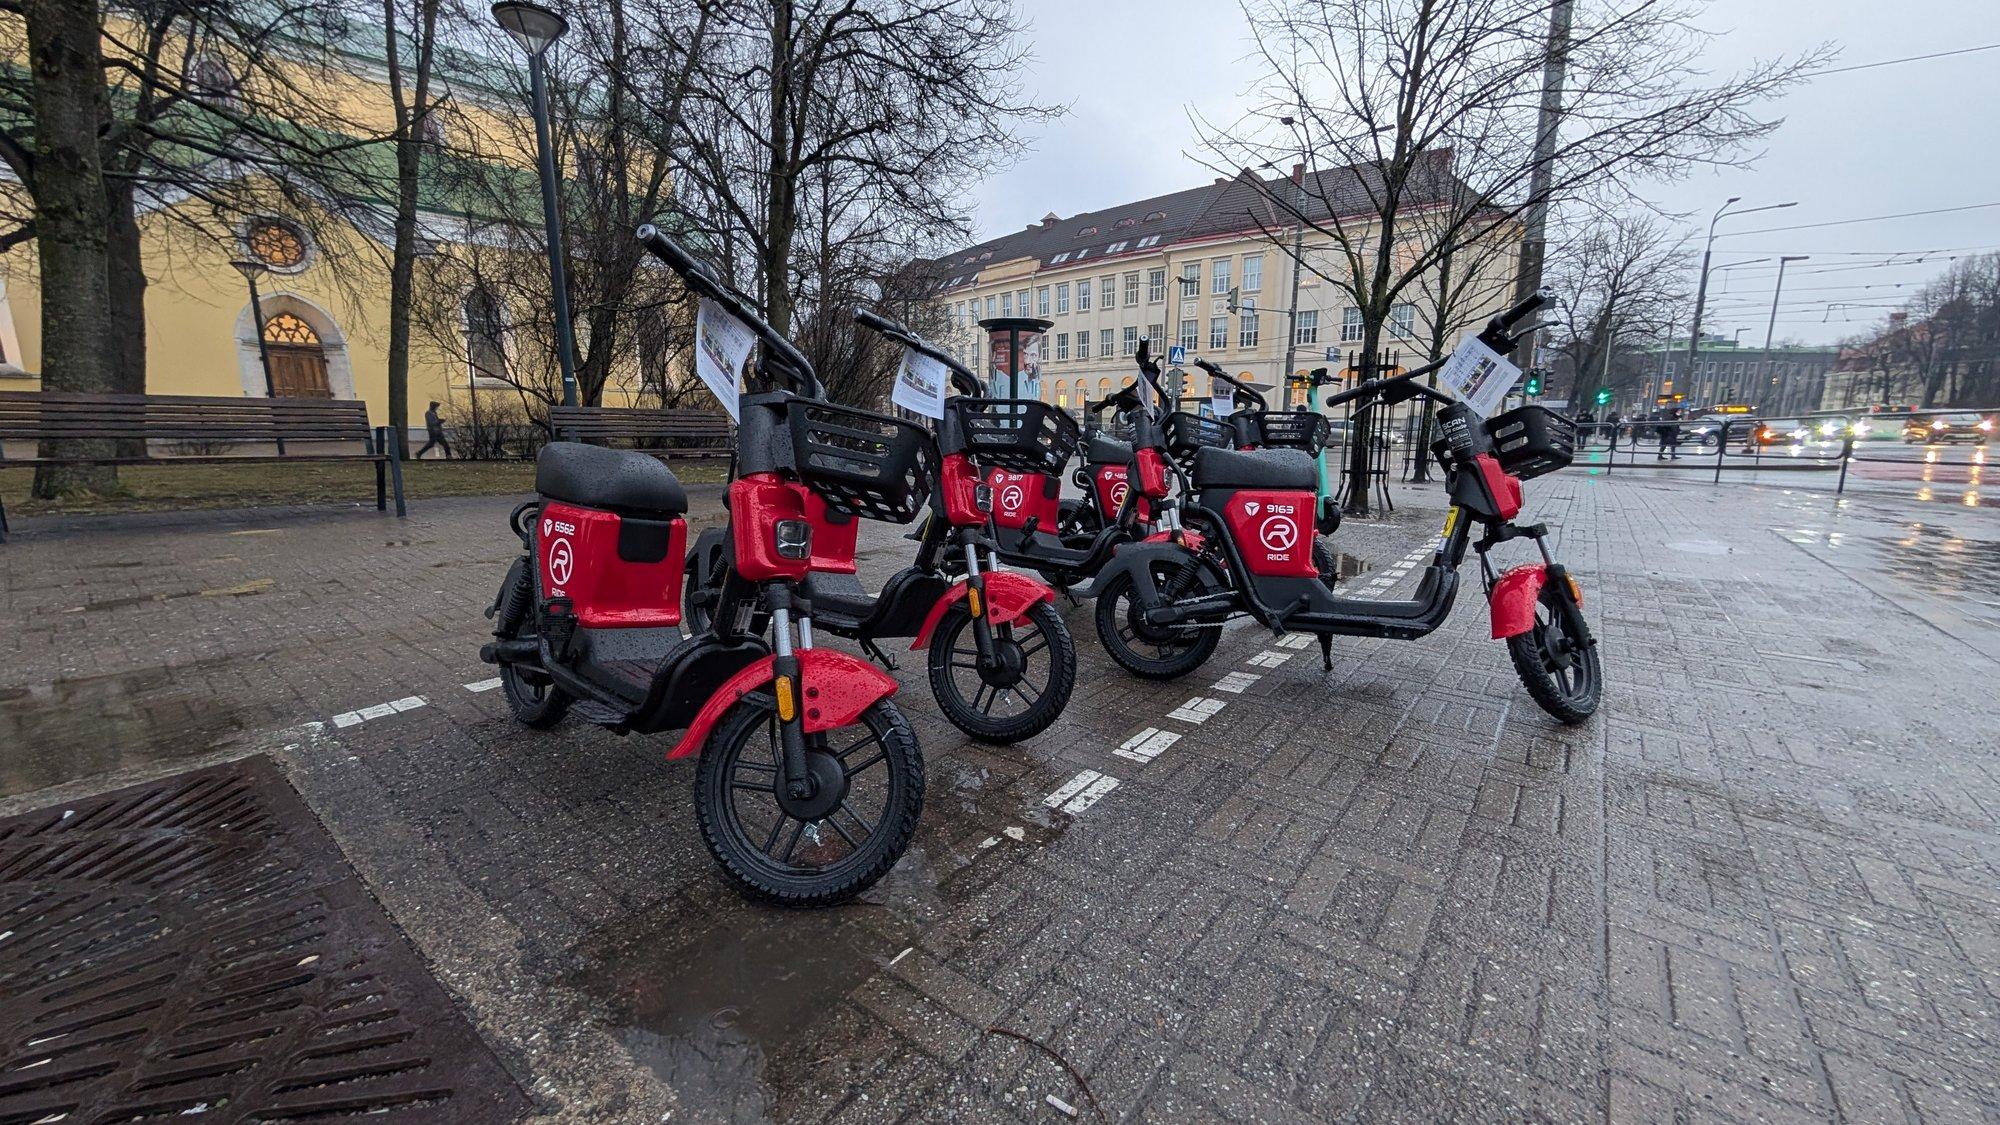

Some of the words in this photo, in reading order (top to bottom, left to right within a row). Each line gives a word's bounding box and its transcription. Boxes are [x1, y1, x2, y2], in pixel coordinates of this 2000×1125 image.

[1442, 416, 1466, 430] SCAN
[1266, 504, 1295, 514] 9163
[554, 521, 576, 536] 6562
[1267, 553, 1290, 561] RIDE
[551, 587, 566, 598] RIDE
